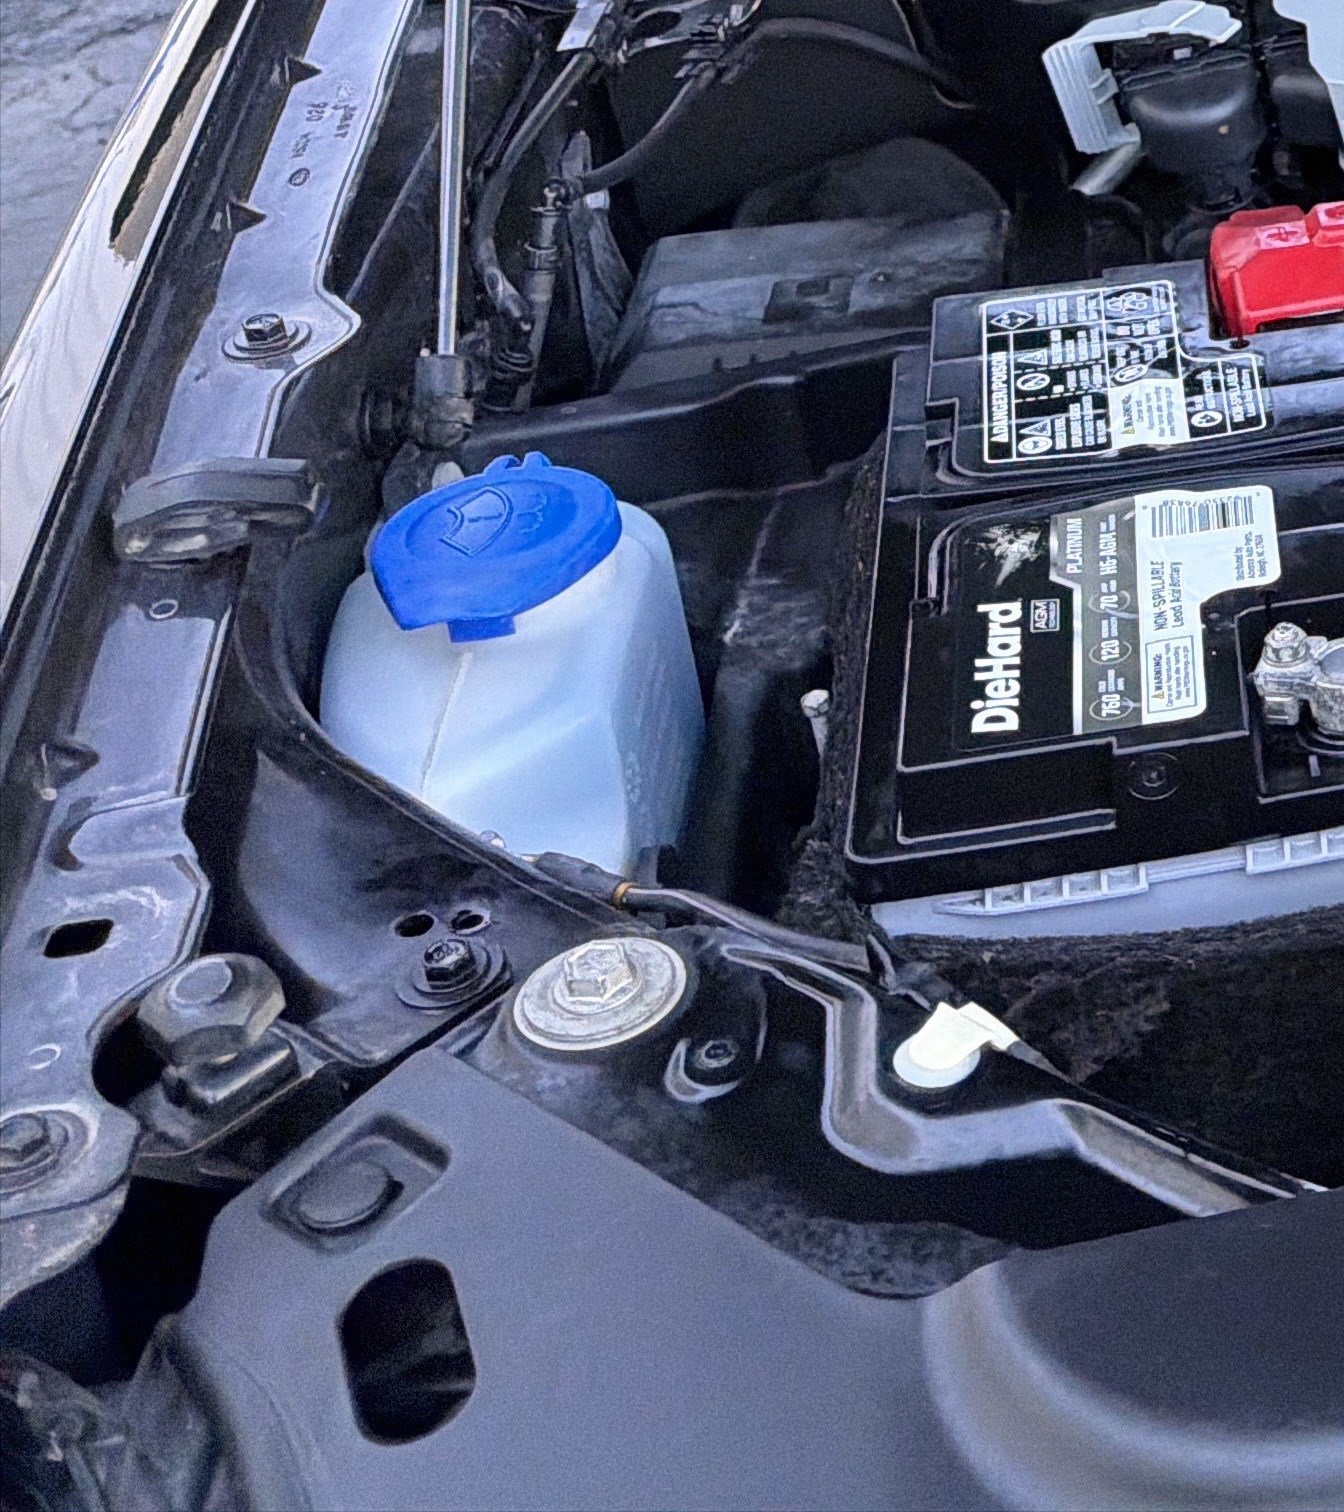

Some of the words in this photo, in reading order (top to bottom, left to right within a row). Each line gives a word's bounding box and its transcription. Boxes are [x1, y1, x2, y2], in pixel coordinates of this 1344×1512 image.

[1066, 517, 1083, 574] PLATINUM
[1099, 531, 1118, 576] H6-AGM
[1169, 562, 1182, 586] Battery
[1100, 594, 1119, 609] 70
[1150, 561, 1169, 631] NON-SPILLABLE
[1170, 587, 1182, 603] Acid
[1035, 601, 1048, 629] AGM
[1171, 604, 1184, 628] Lead
[1101, 639, 1120, 661] 120
[970, 601, 1022, 733] DieHard
[1101, 693, 1121, 718] 760
